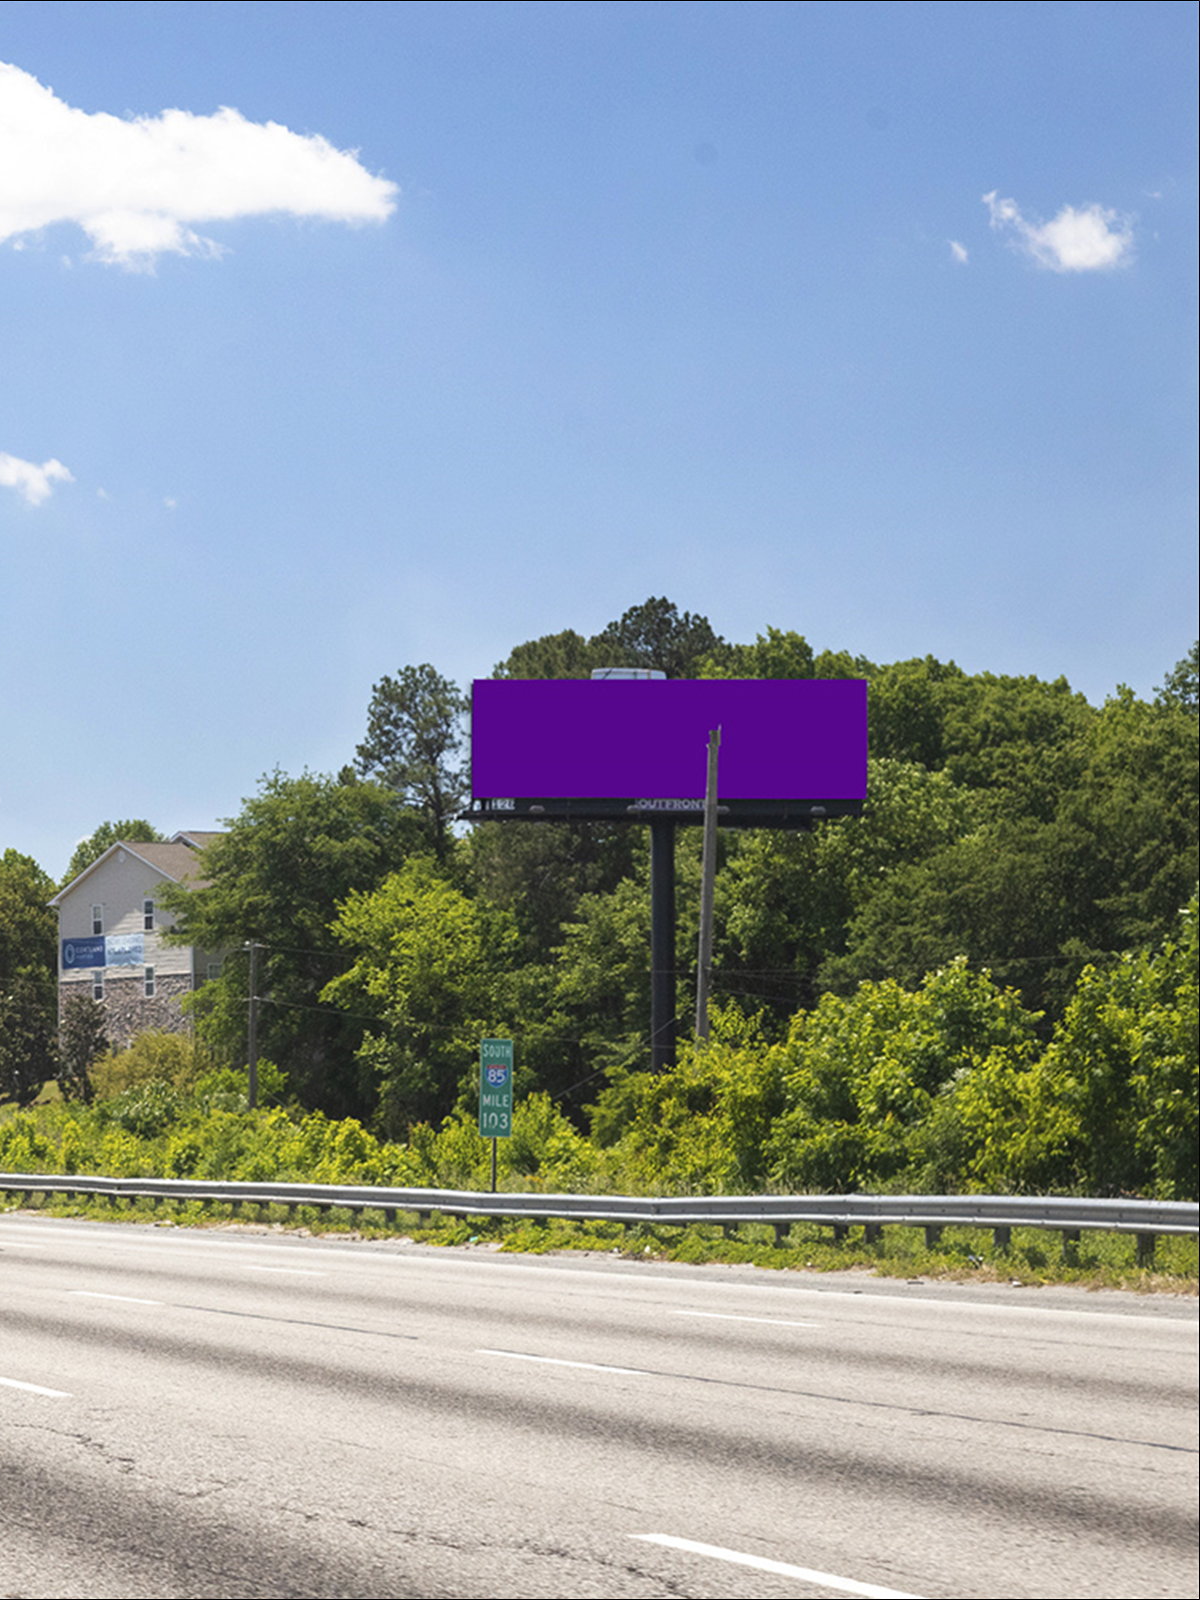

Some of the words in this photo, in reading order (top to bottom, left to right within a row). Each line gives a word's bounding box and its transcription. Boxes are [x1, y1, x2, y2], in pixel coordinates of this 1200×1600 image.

[483, 1044, 511, 1058] SOUTH
[488, 1069, 506, 1083] 85
[482, 1094, 509, 1108] MILE
[483, 1112, 509, 1129] 103
